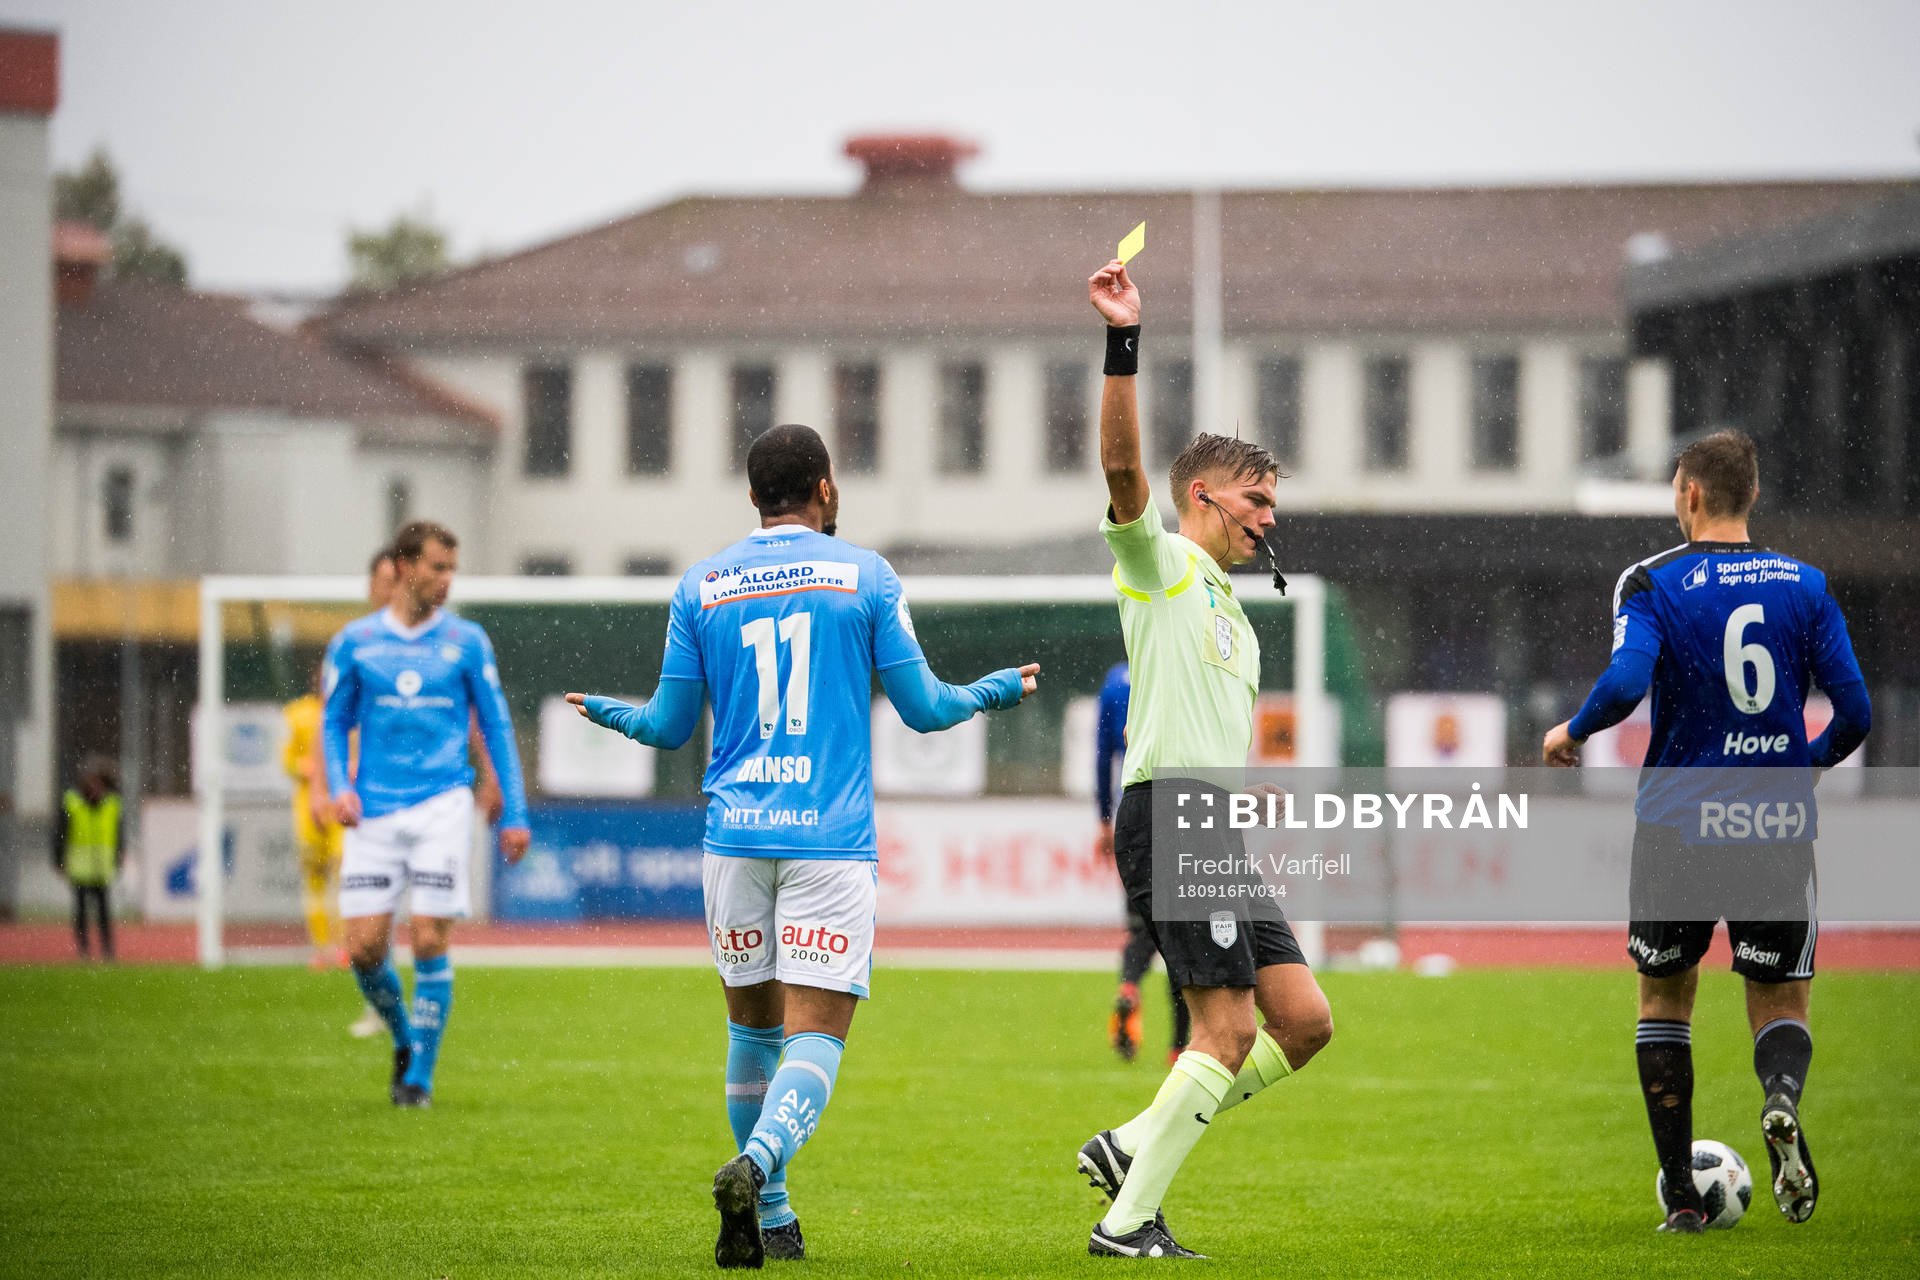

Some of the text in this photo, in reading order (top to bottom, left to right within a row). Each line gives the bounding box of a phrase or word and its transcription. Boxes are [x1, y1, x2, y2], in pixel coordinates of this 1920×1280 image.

[739, 566, 814, 586] ÅLGÅRD
[1716, 557, 1799, 574] sparebanken
[1718, 569, 1801, 586] sogn og fjordane
[713, 577, 844, 601] LANDBRUKSSENTER
[1723, 603, 1776, 715] 6
[740, 611, 811, 740] 11
[1723, 732, 1790, 756] Hove
[723, 807, 819, 826] MITT VALG!
[782, 925, 849, 955] auto
[791, 949, 830, 964] 2000
[1736, 941, 1781, 966] Tekstil
